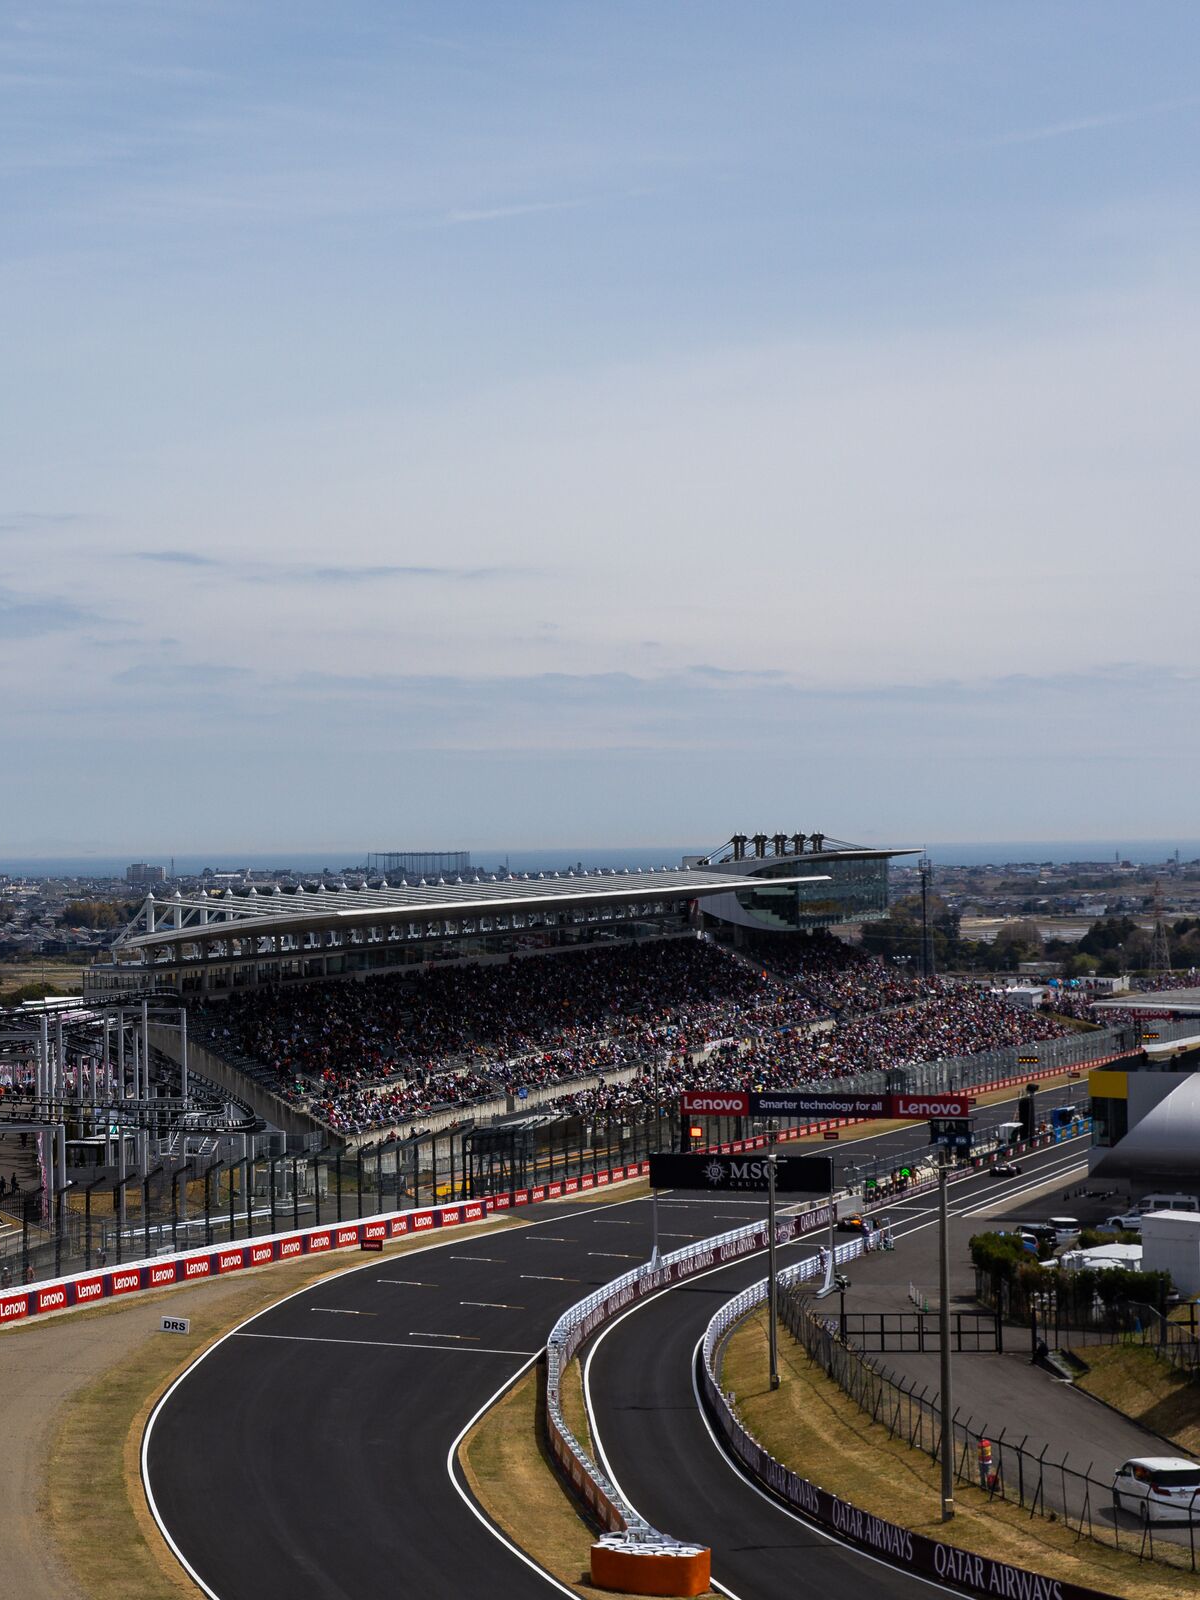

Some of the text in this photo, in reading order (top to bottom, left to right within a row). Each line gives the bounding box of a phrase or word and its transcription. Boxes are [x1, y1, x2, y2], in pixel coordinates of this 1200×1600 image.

[684, 1096, 743, 1110] Lenovo
[759, 1099, 883, 1112] Smarter technology for all
[899, 1101, 961, 1114] Lenovo
[442, 1209, 459, 1222] Lenovo
[465, 1203, 482, 1217] Lenovo
[391, 1219, 407, 1233] Lenovo
[414, 1213, 433, 1227] Lenovo
[800, 1212, 817, 1231] QATAR
[339, 1230, 357, 1244] Lenovo
[366, 1225, 385, 1238] Lenovo
[282, 1241, 300, 1255] Lenovo
[311, 1236, 330, 1250] Lenovo
[720, 1235, 756, 1260] QATAR AIRWAYS
[221, 1254, 241, 1268] Lenovo
[253, 1248, 272, 1262] Lenovo
[186, 1260, 209, 1275] Lenovo
[678, 1251, 714, 1278] QATAR AIRWAYS
[114, 1274, 138, 1289] Lenovo
[152, 1267, 174, 1282] Lenovo
[77, 1281, 101, 1297] Lenovo
[40, 1291, 64, 1306] Lenovo
[0, 1301, 26, 1317] Lenovo
[163, 1320, 186, 1331] DRS
[788, 1474, 819, 1514] AIRWAYS
[832, 1499, 913, 1560] QATAR AIRWAYS
[934, 1543, 1063, 1600] QATAR AIRWAYS
